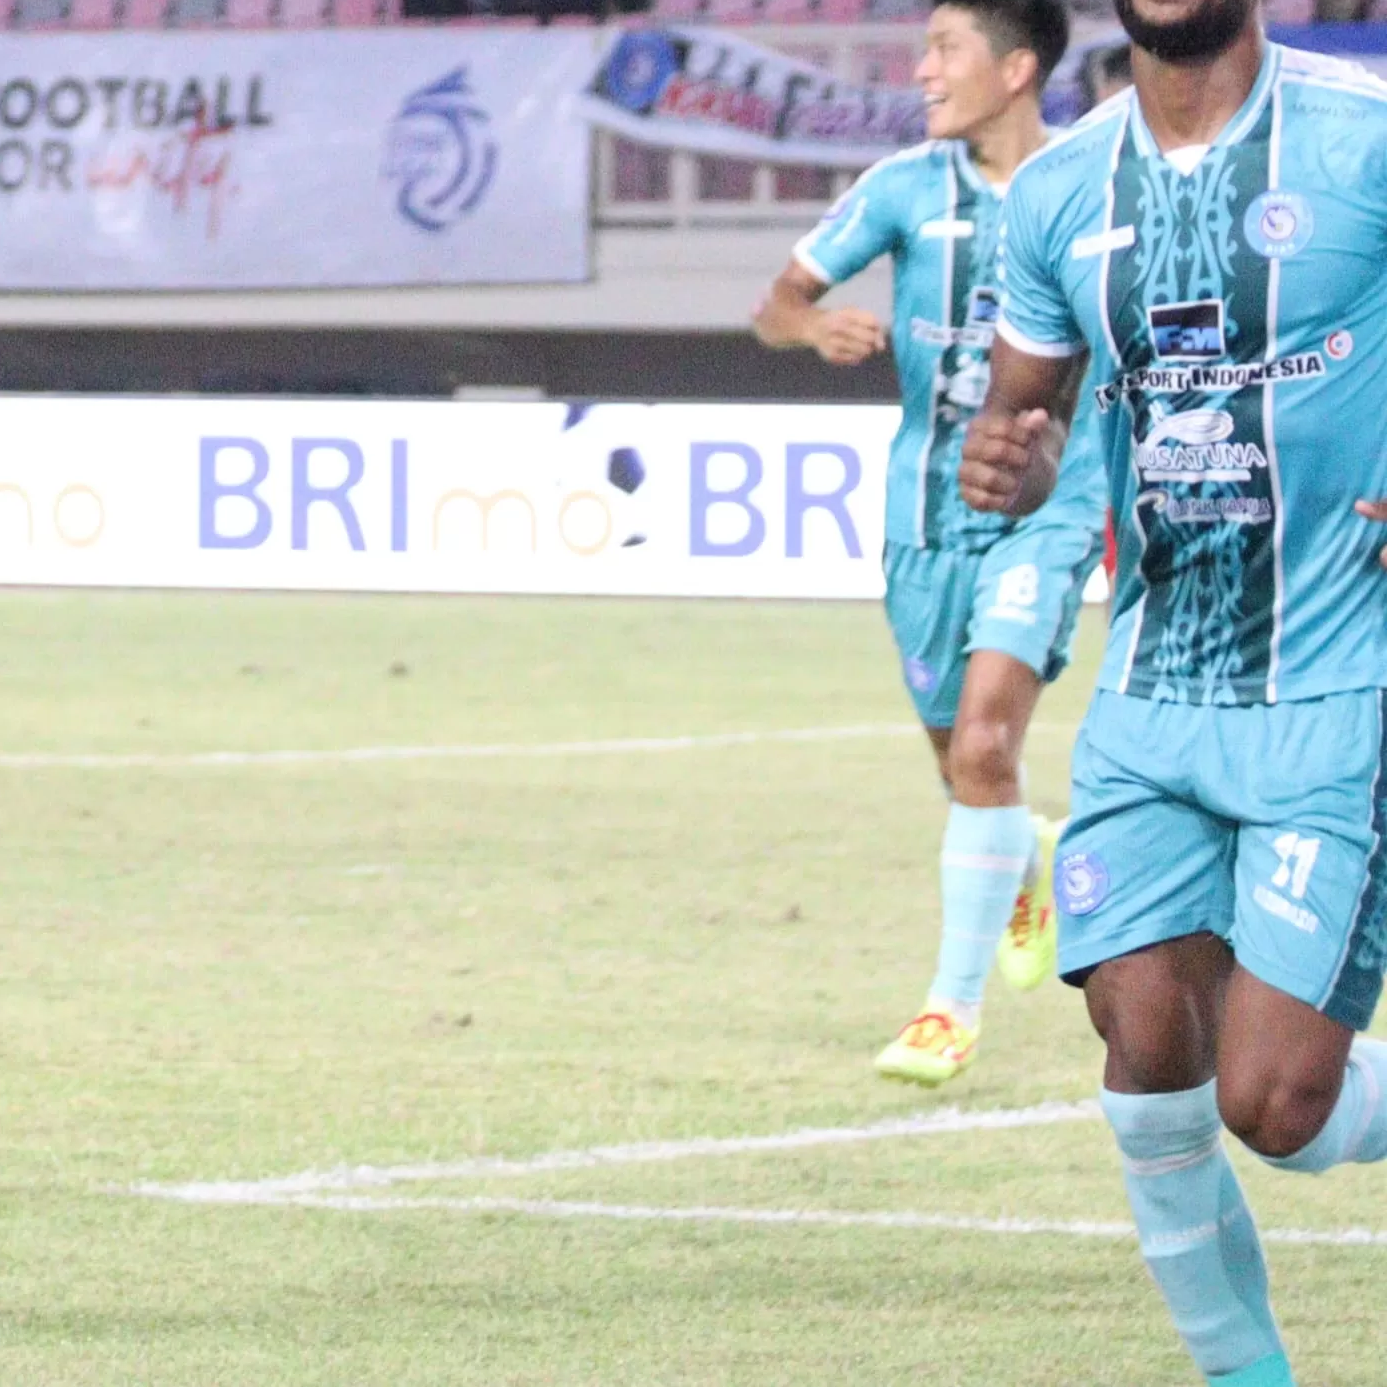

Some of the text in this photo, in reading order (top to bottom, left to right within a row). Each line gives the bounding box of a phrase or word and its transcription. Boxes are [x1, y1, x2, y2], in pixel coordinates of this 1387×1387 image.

[1190, 354, 1323, 389] INDONESIA
[689, 441, 864, 559] BR
[1271, 831, 1321, 901] 11
